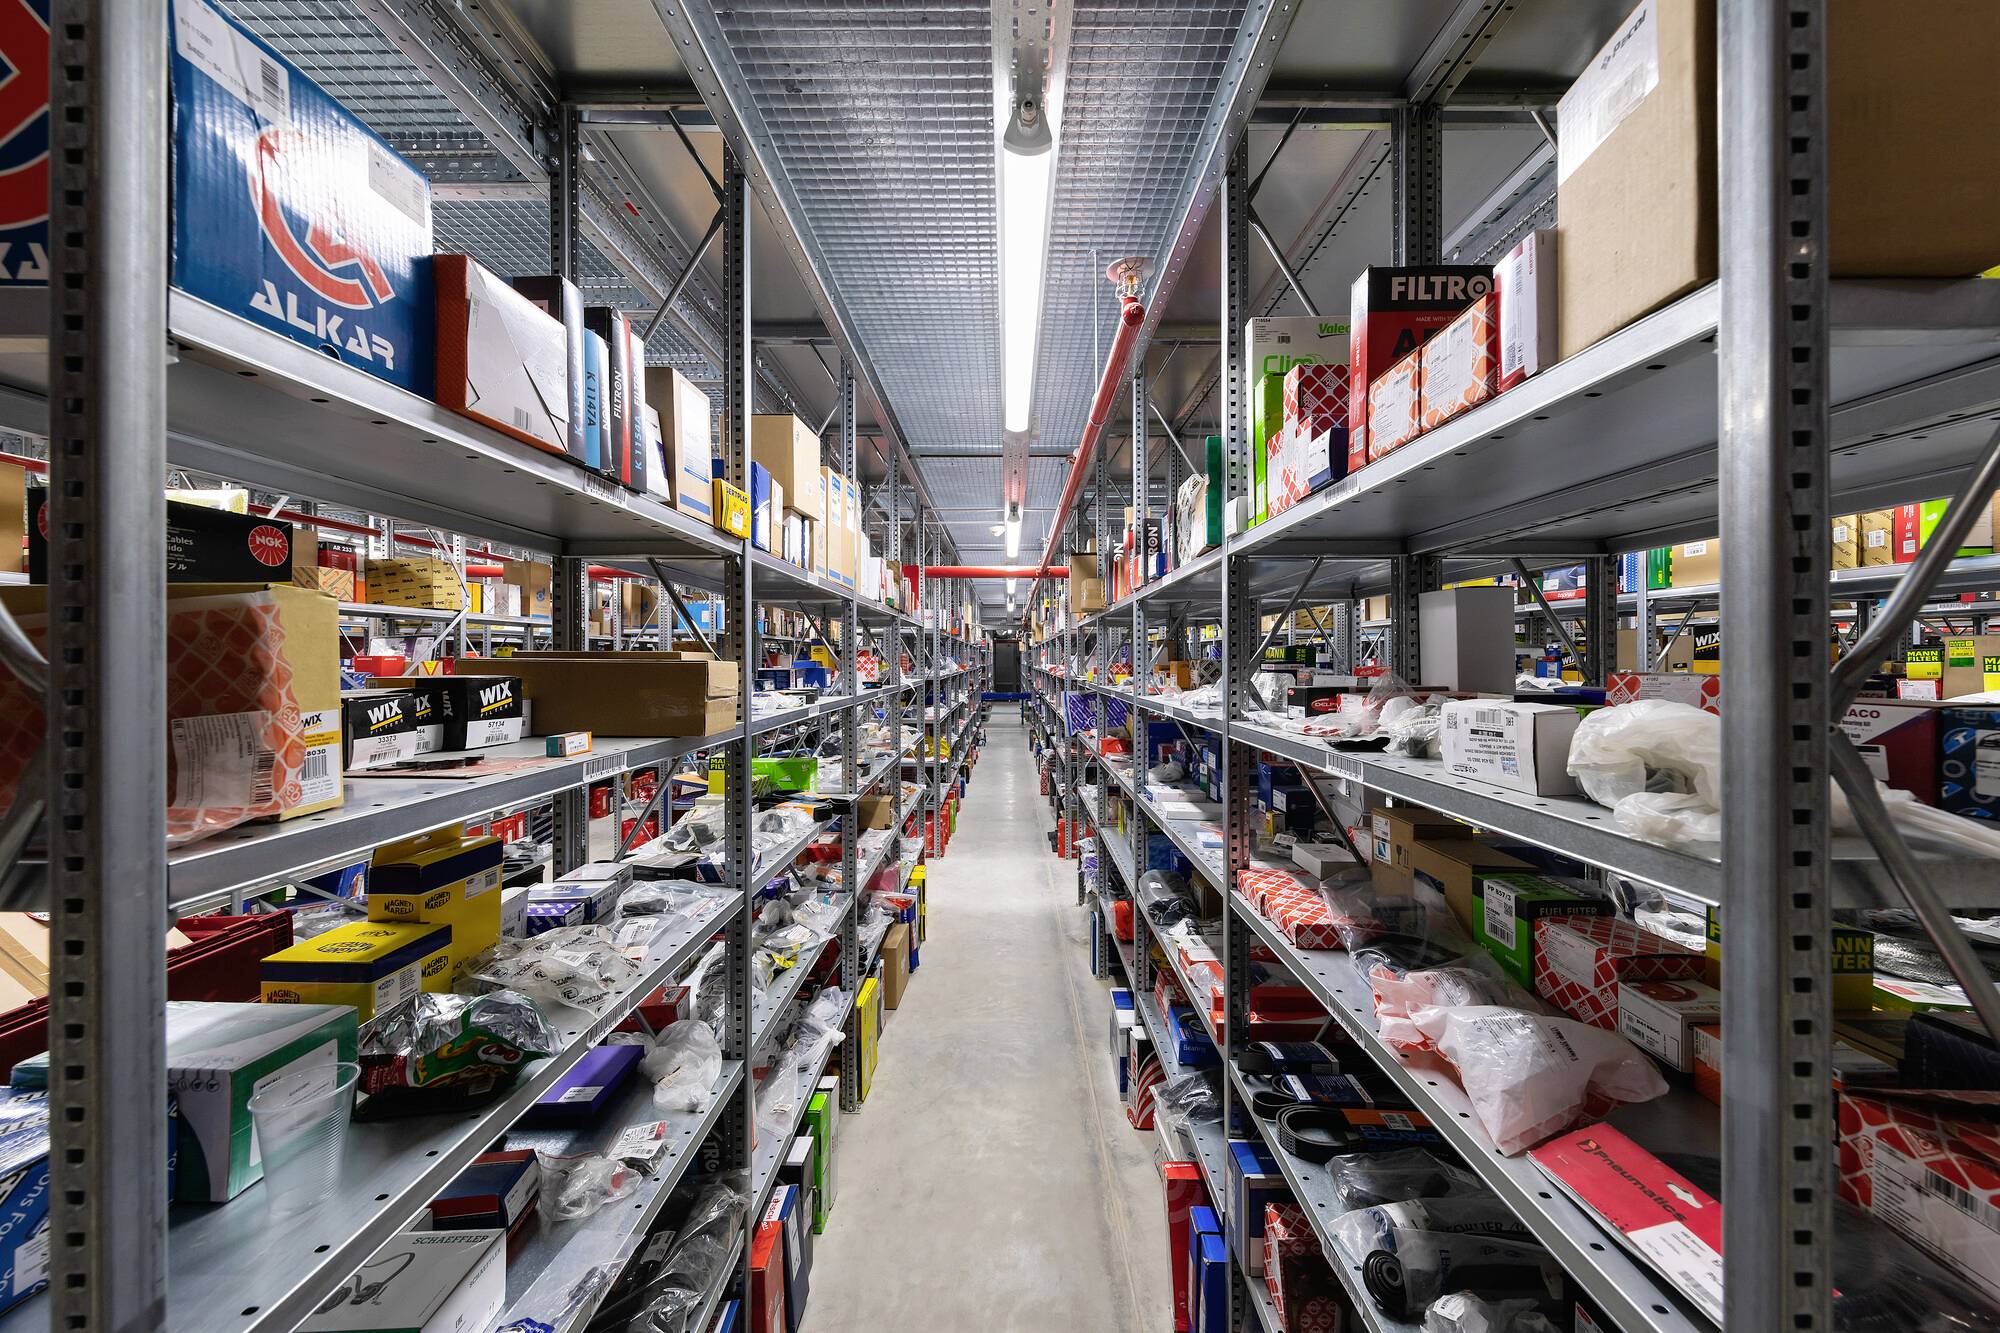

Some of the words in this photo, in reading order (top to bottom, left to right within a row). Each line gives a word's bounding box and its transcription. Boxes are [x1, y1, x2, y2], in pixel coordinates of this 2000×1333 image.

[1391, 275, 1492, 301] FILTRO
[248, 278, 395, 371] ALKAR
[613, 367, 623, 419] FILTRON
[586, 386, 597, 427] 1147A
[255, 534, 283, 548] NGK
[1265, 648, 1286, 659] MANN
[480, 681, 513, 706] WIX
[415, 694, 432, 712] IX
[302, 712, 323, 728] WIX
[367, 700, 402, 725] WIX
[1843, 708, 1881, 719] ACO
[487, 720, 505, 728] 57134
[377, 735, 397, 744] 33373
[304, 748, 326, 758] 8030
[1487, 884, 1495, 893] PP
[1495, 887, 1512, 901] 857/3
[1539, 907, 1562, 916] FUEL
[1567, 906, 1599, 915] FILTER
[1593, 1145, 1688, 1222] Pneumatics
[412, 1235, 489, 1245] SCHAEFFLER
